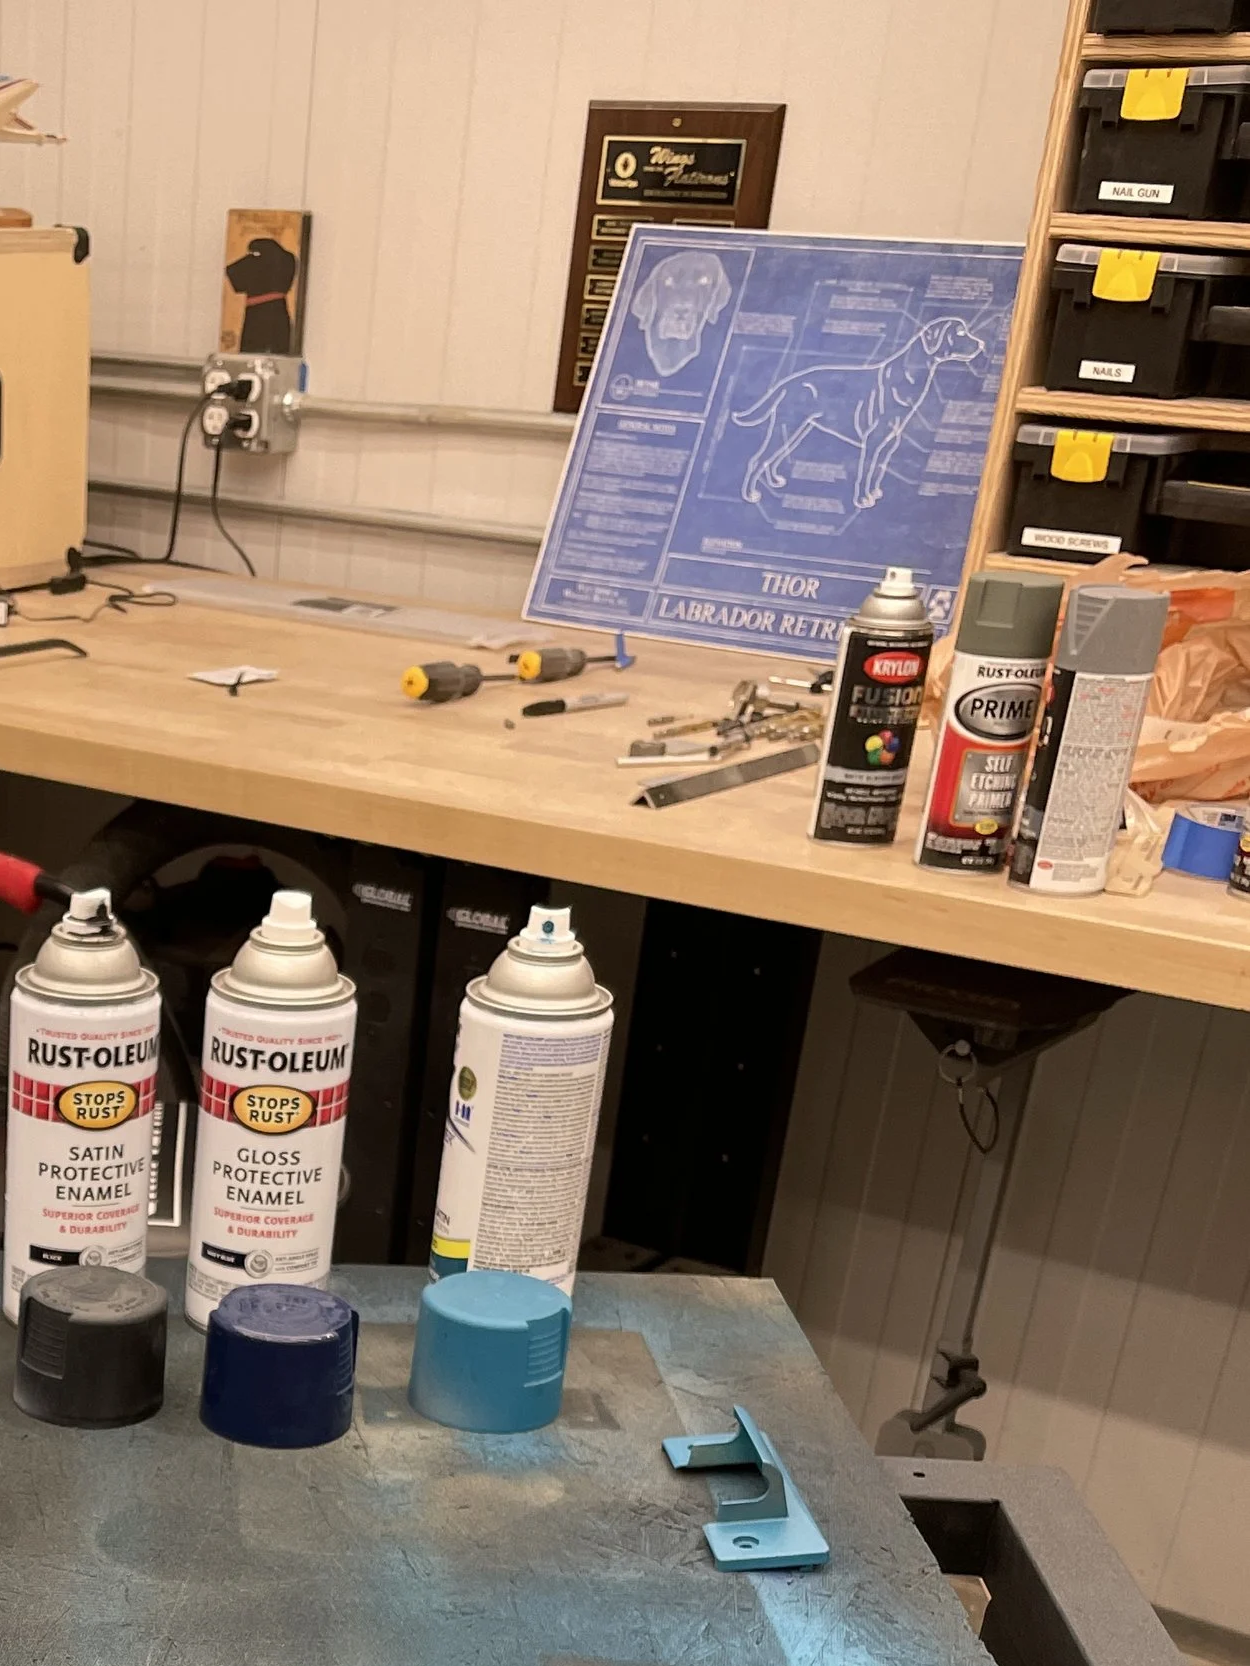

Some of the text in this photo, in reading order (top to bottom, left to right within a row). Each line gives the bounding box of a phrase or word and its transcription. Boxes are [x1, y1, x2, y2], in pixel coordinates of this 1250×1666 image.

[1113, 187, 1160, 198] NAIL GUN
[1093, 367, 1121, 377] NAILS
[1034, 534, 1109, 549] WOOD SCREWS
[761, 571, 820, 599] THOR
[659, 597, 776, 632] LABRADOR
[873, 658, 920, 676] KRYLON
[985, 756, 1013, 772] SELF
[211, 1036, 346, 1073] RUST-OLEUM
[73, 1090, 125, 1106] STOPS
[247, 1095, 300, 1110] STOPS
[76, 1106, 120, 1120] RUST
[249, 1110, 295, 1124] RUST
[69, 1144, 125, 1161] SATIN
[237, 1148, 301, 1165] GLOSS
[39, 1157, 145, 1181] PROTECTIVE
[213, 1161, 322, 1186] PROTECTIVE
[56, 1183, 132, 1201] ENAMEL
[227, 1186, 305, 1205] ENAMEL
[42, 1204, 140, 1221] SUPERIOR COVERAGE
[214, 1206, 314, 1225] SUPERIOR COVERAGE
[70, 1222, 127, 1234] DURABILITY
[227, 1225, 298, 1238] & DURABILITY
